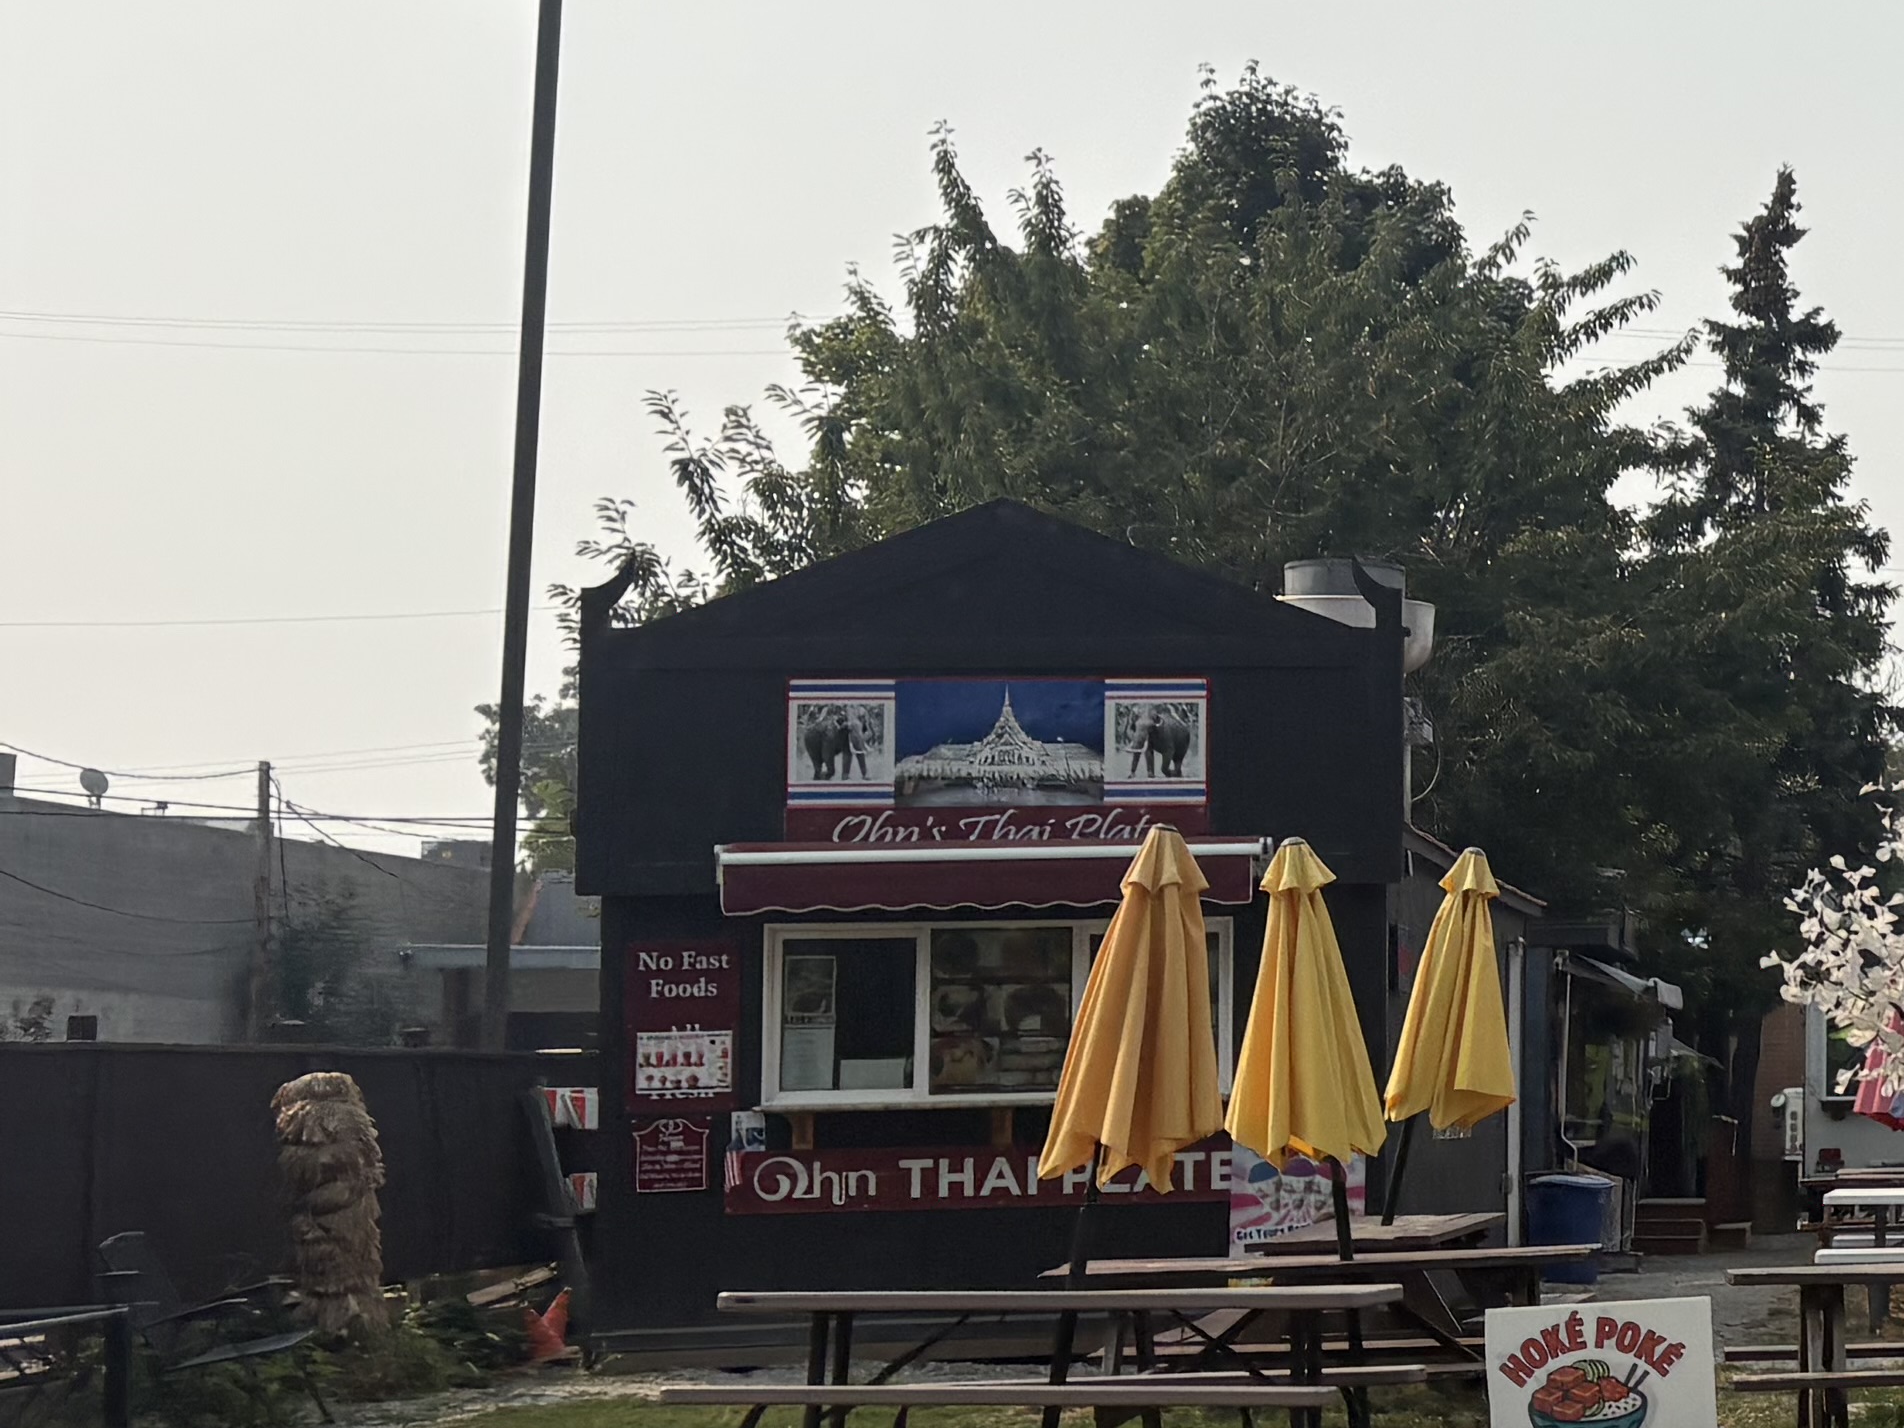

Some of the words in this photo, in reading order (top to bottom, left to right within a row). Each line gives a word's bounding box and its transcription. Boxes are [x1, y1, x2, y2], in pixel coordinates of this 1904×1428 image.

[832, 810, 947, 843] Ohn's
[958, 808, 1052, 842] Thai
[1066, 807, 1154, 841] Plat
[637, 951, 674, 971] No
[681, 950, 731, 970] Fast
[649, 976, 718, 998] Foods
[899, 1154, 1039, 1200] THAI
[1499, 1310, 1588, 1389] HOKÉ
[1594, 1316, 1687, 1378] POKÉ
